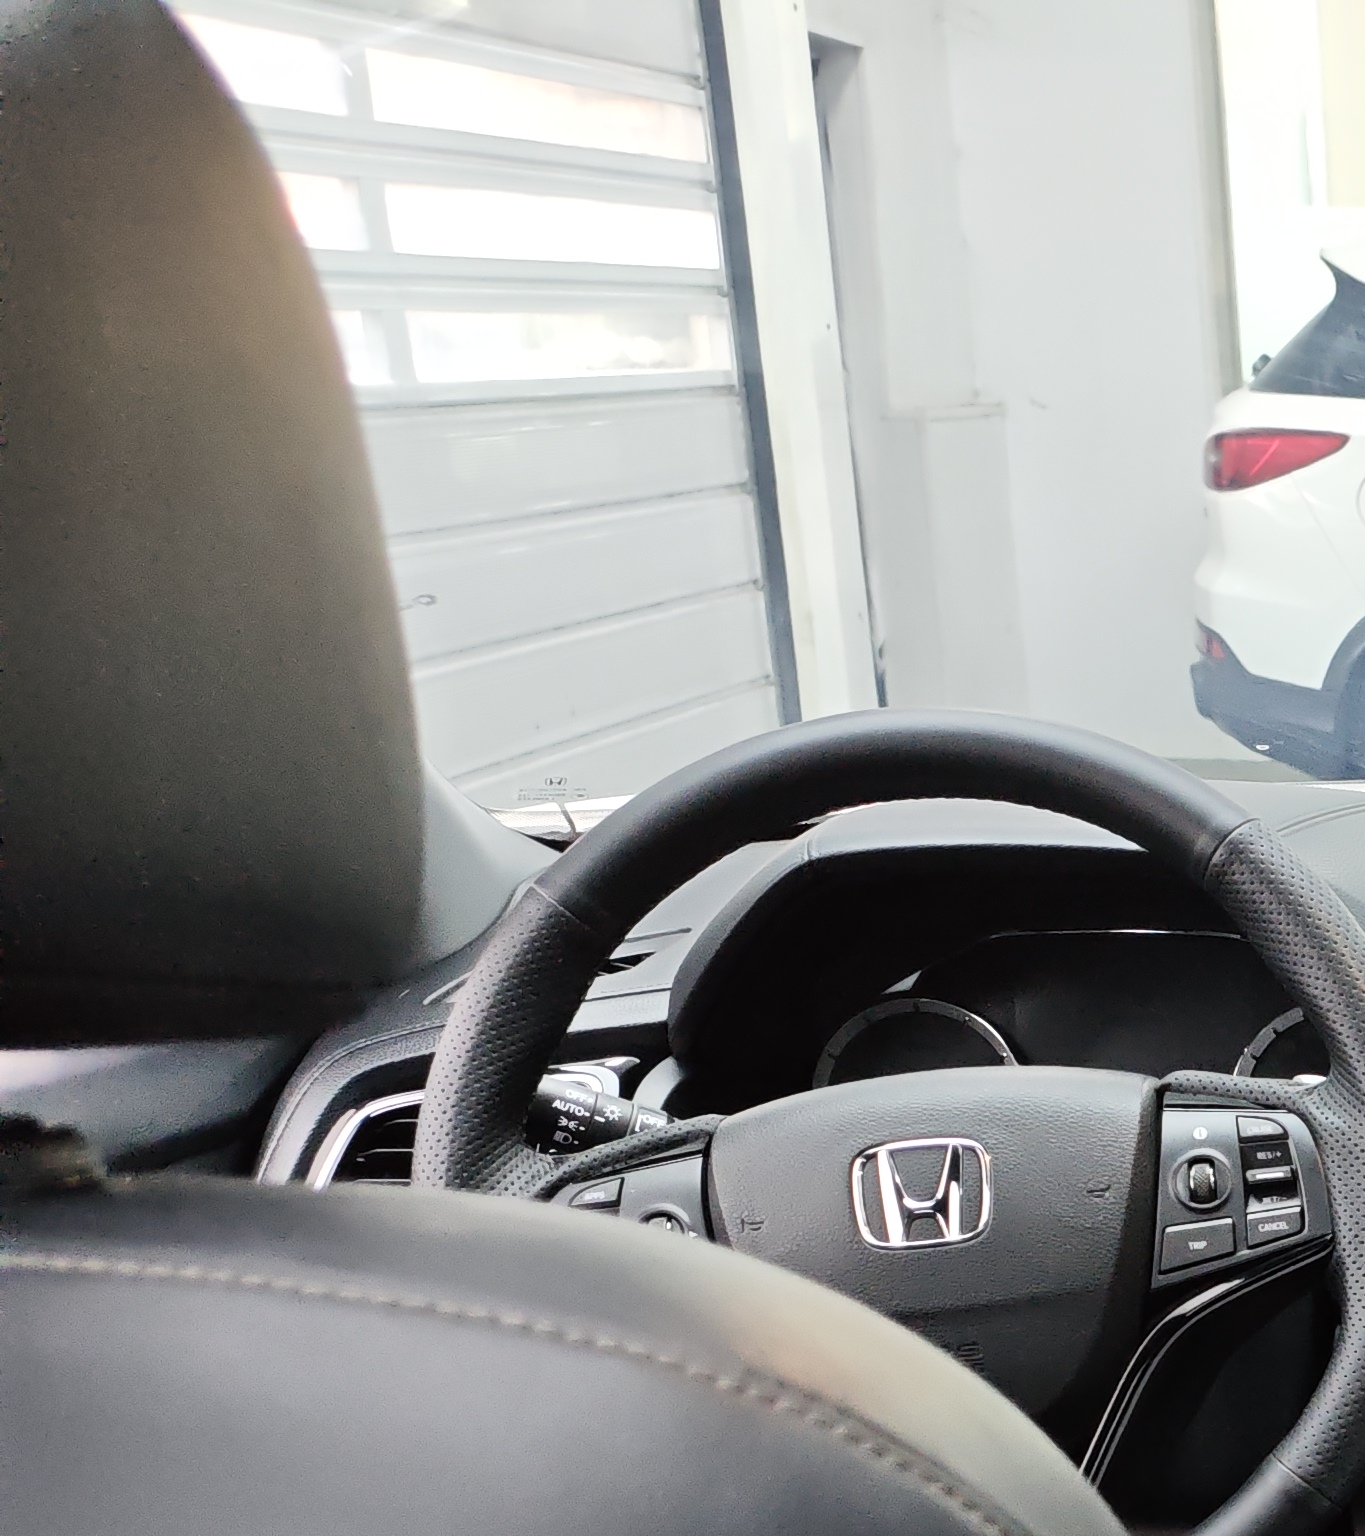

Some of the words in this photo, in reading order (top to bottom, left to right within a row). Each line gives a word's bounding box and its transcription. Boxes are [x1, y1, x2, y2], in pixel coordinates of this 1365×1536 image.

[566, 1089, 587, 1102] OFF
[552, 1099, 584, 1116] AUTO
[642, 1115, 666, 1128] OFF
[1257, 1221, 1290, 1232] CANCEL
[1187, 1240, 1208, 1251] TRIP
